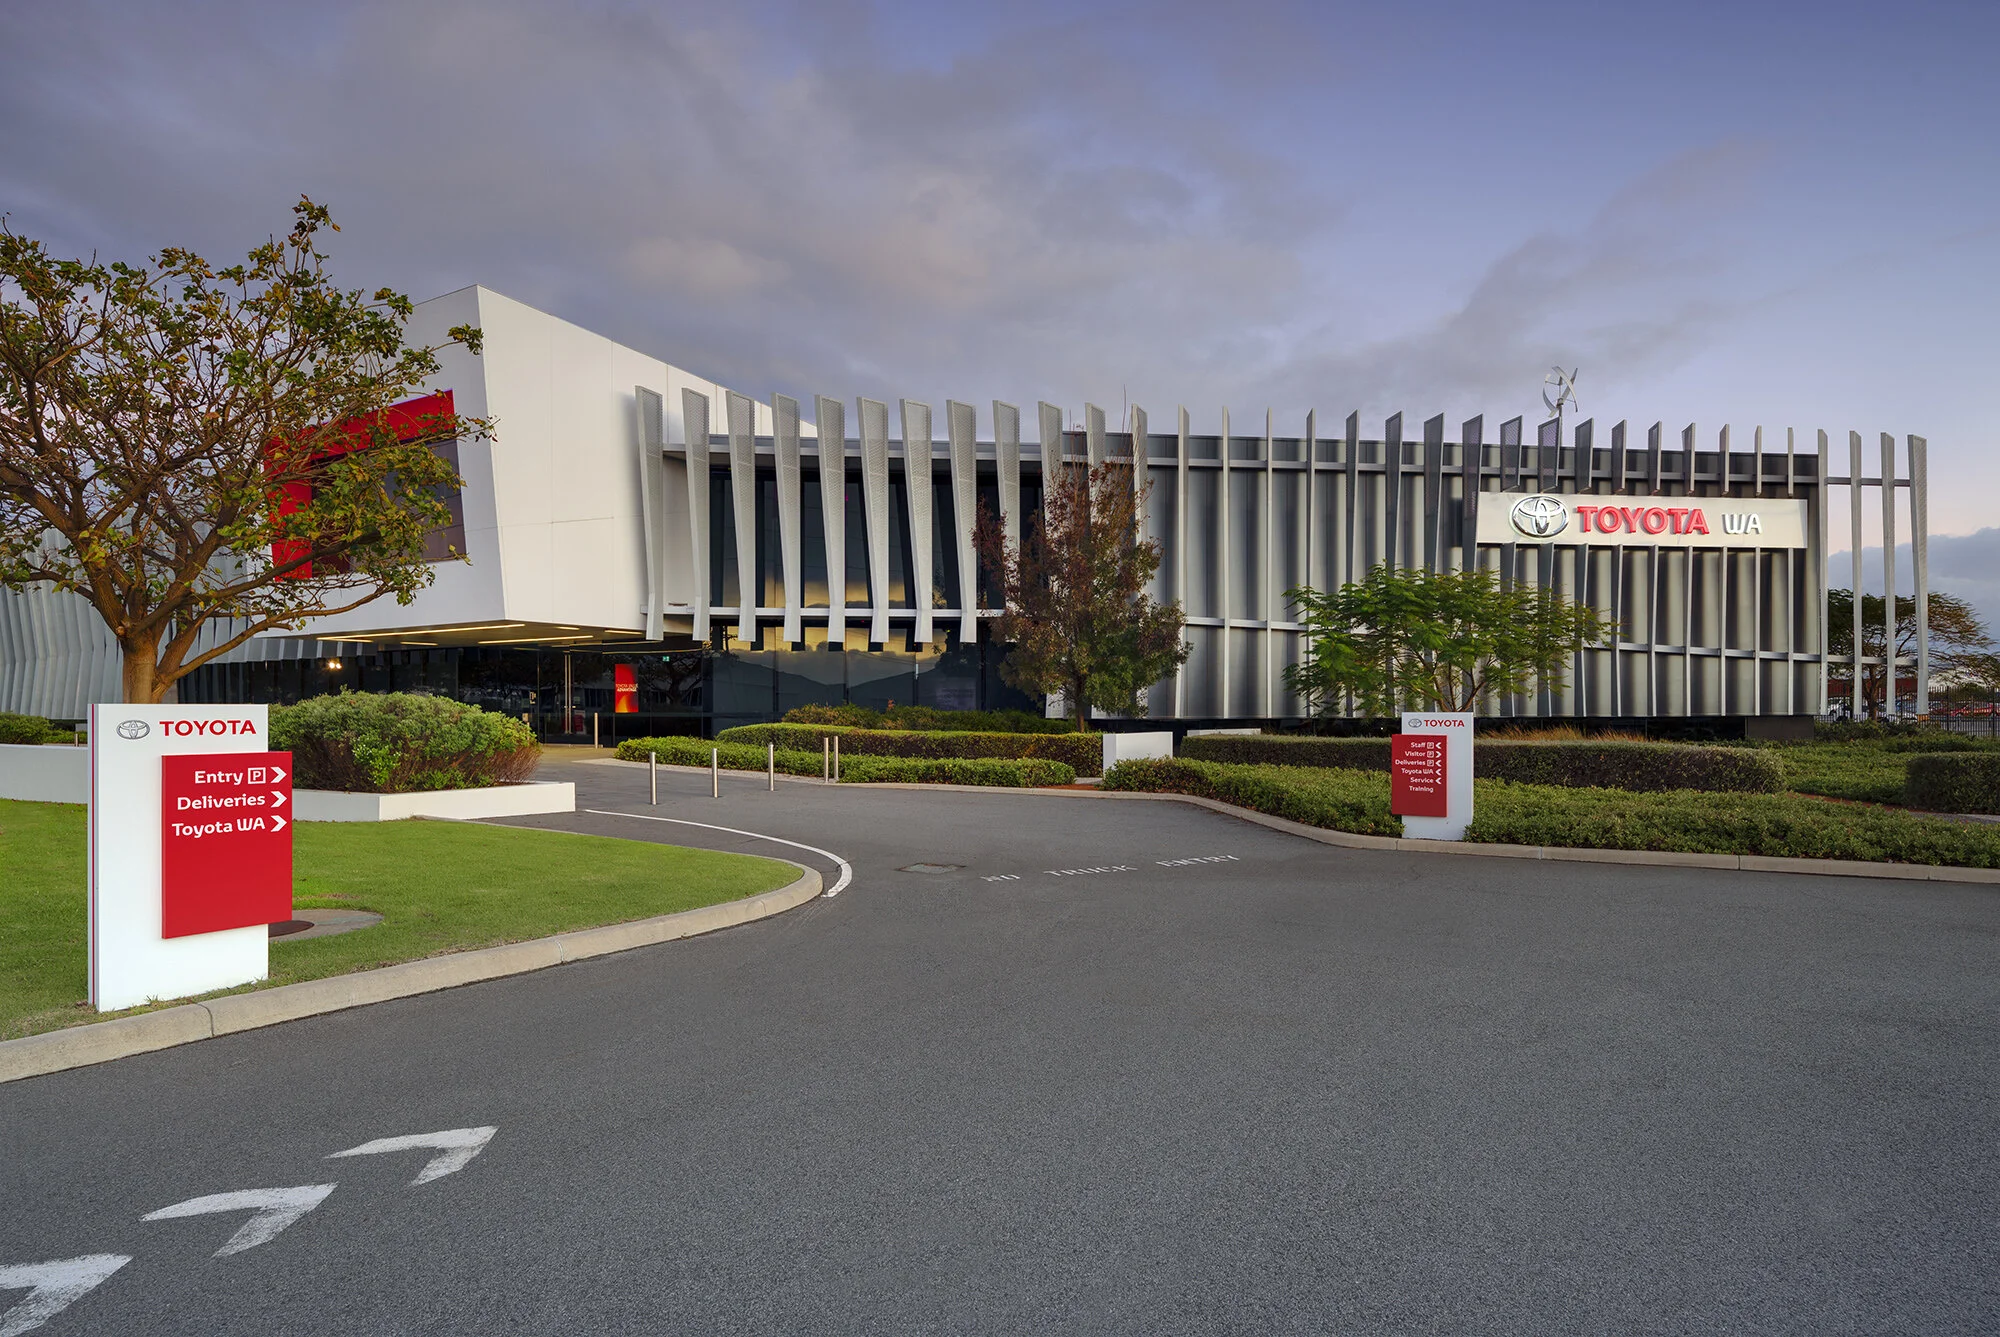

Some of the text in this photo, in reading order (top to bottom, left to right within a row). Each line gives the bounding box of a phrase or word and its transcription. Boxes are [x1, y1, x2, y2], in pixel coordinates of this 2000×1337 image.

[1576, 506, 1763, 535] TOYOTA WA
[159, 719, 257, 737] TOYOTA
[1424, 719, 1465, 727] TOYOTA
[194, 770, 244, 785] Entry
[177, 793, 266, 811] Deliveries
[171, 817, 266, 838] Toyota WA
